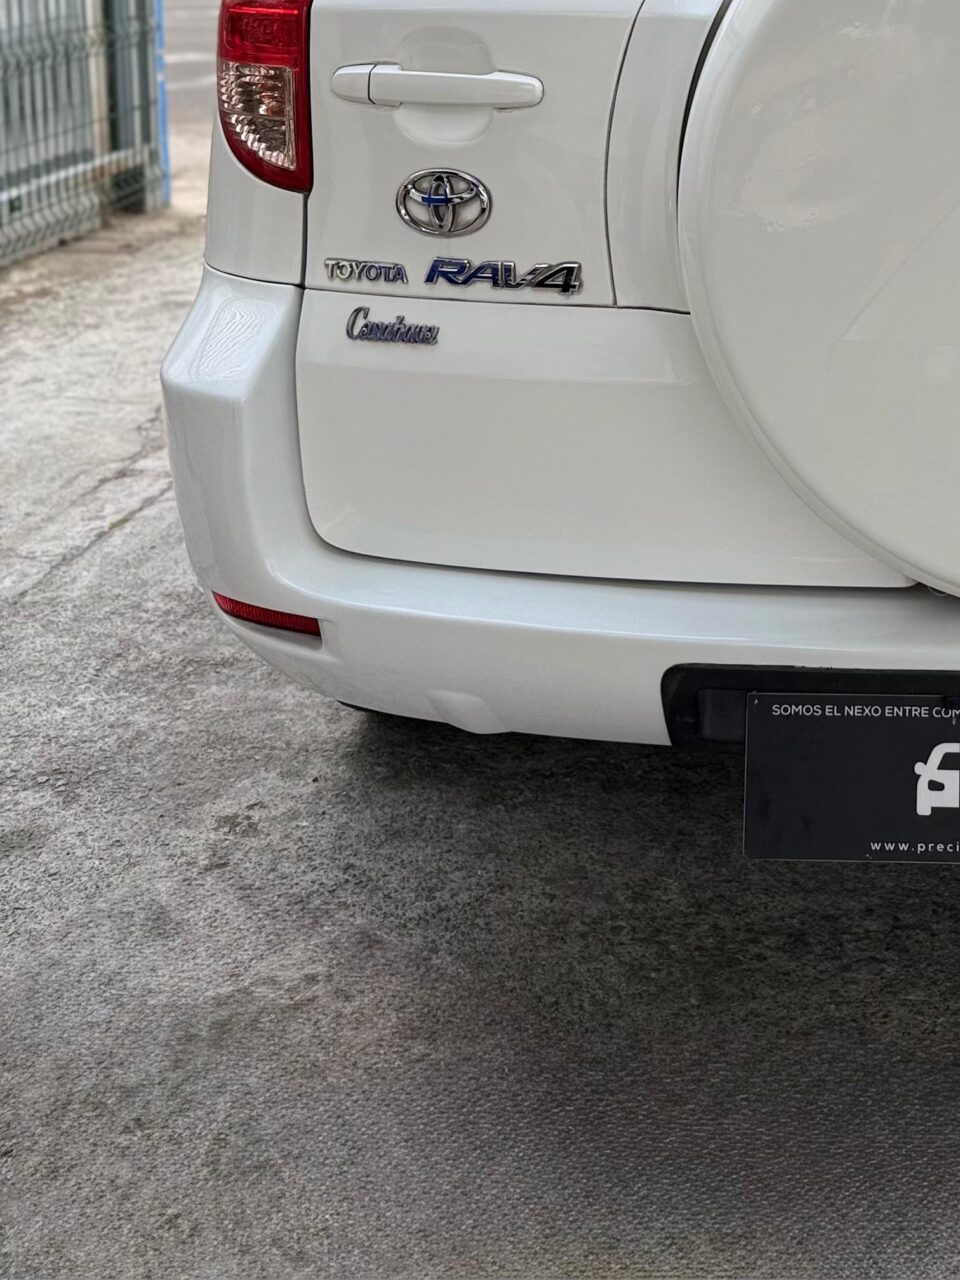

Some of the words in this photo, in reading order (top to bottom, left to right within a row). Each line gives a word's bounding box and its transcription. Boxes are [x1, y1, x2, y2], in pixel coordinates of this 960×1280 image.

[324, 257, 409, 285] TOYOTA
[424, 256, 584, 296] RAV4
[771, 704, 823, 717] SOMOS
[825, 705, 842, 717] EL
[844, 705, 882, 718] NEXO
[885, 706, 930, 718] ENTRE
